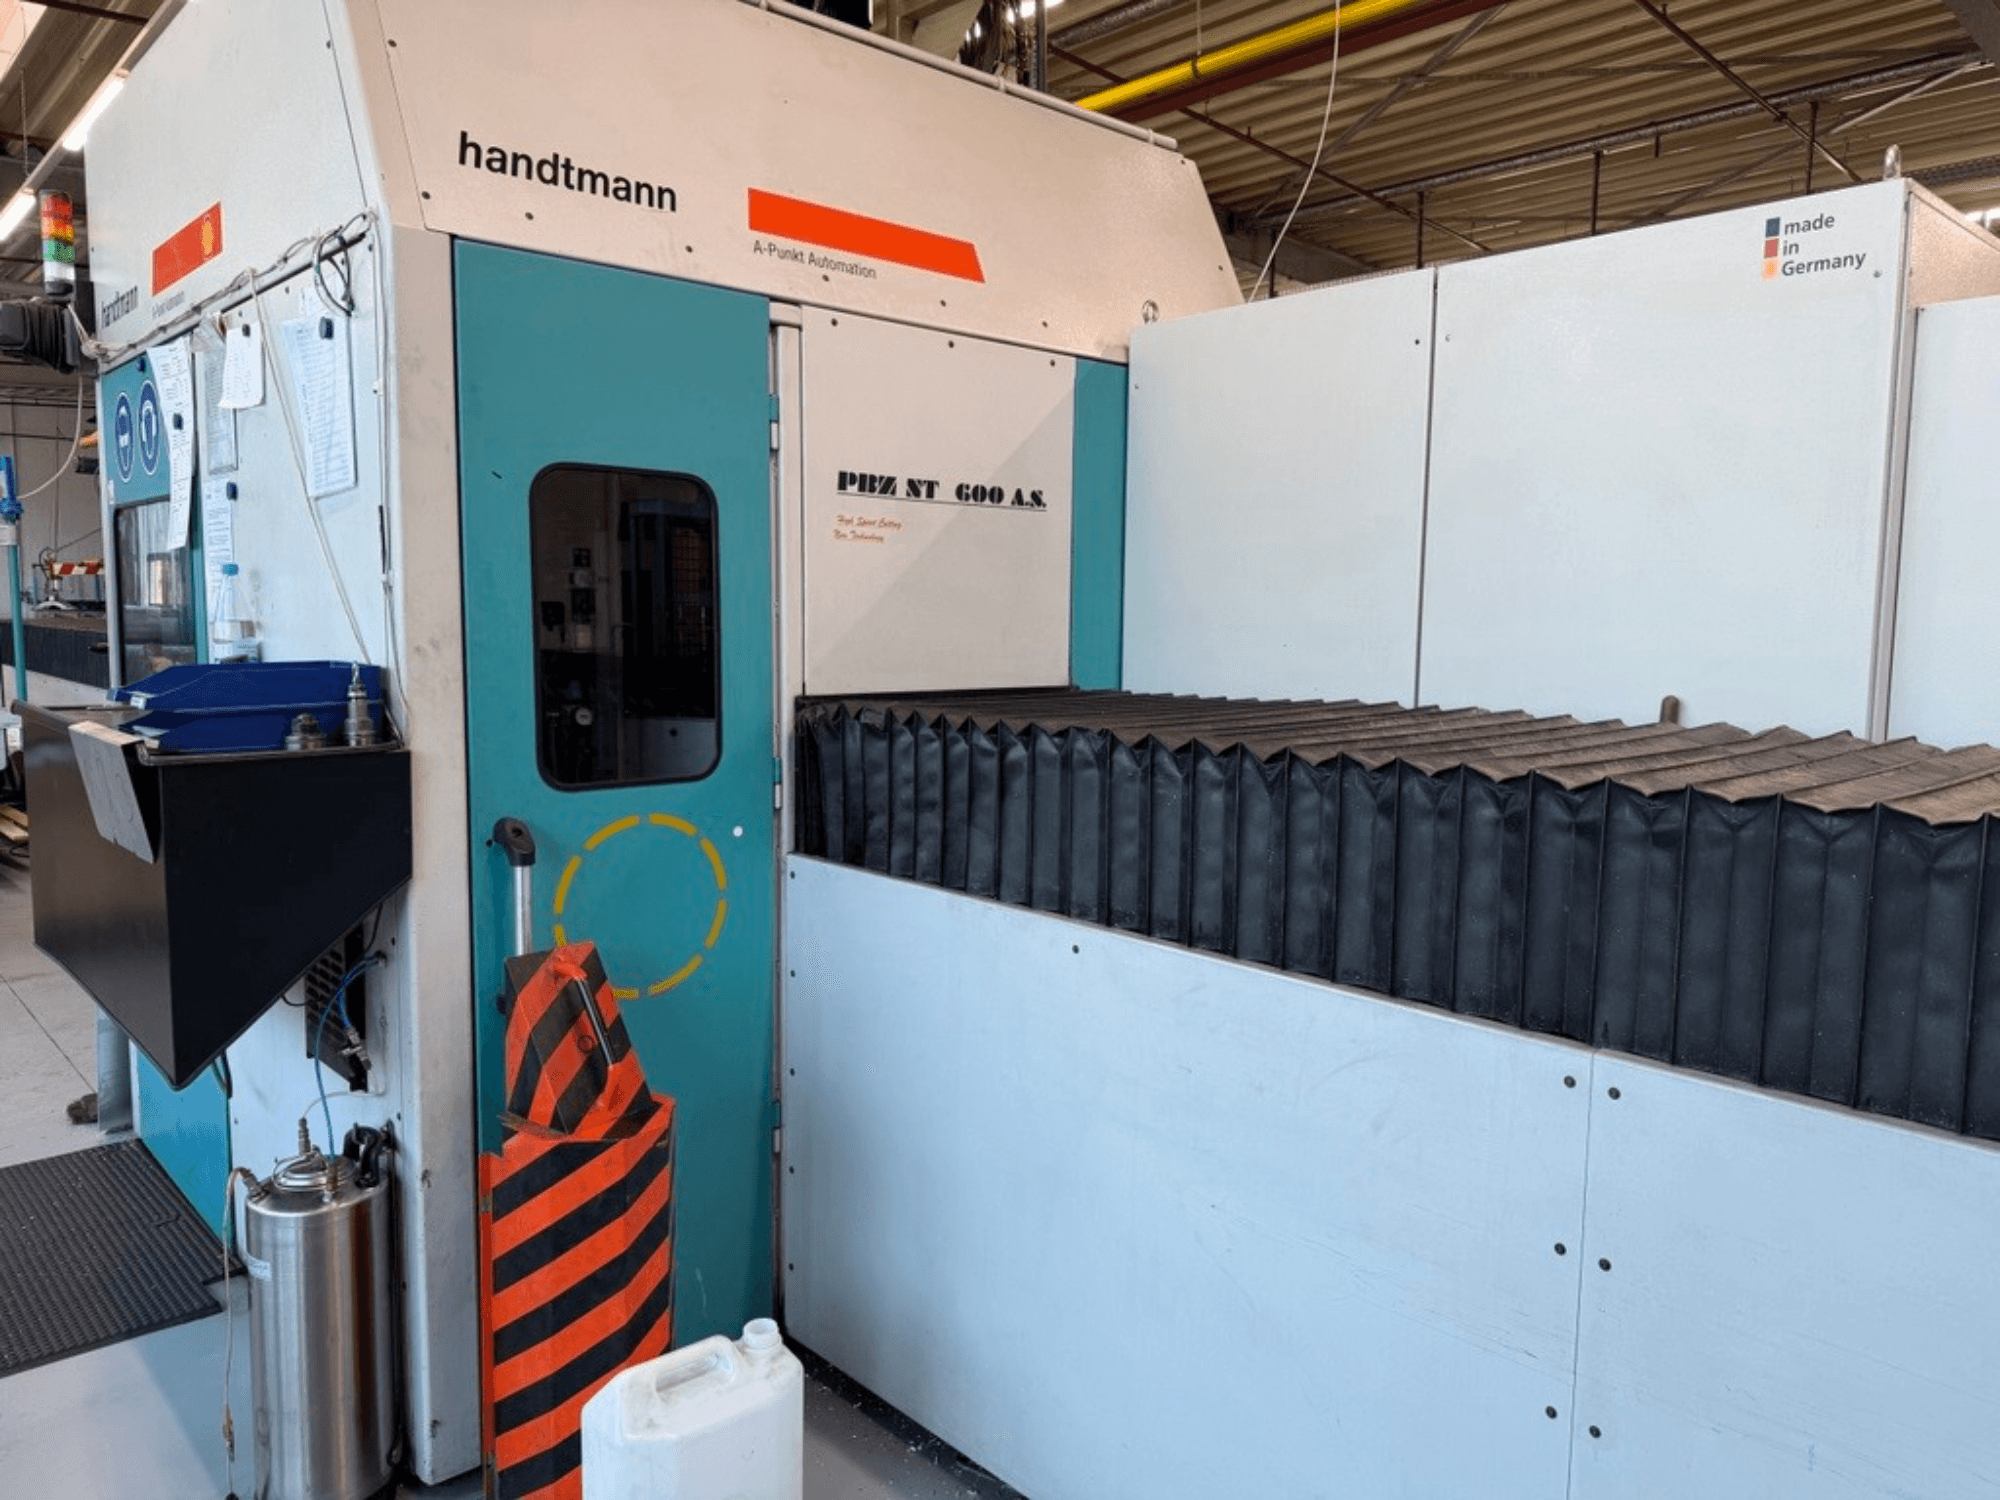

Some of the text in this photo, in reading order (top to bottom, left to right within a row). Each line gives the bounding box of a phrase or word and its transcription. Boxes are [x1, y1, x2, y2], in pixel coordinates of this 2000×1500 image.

[459, 131, 677, 212] handtmann
[1784, 213, 1835, 235] made
[753, 240, 877, 279] A-Punkt Automation
[1782, 240, 1799, 256] in
[1781, 253, 1867, 276] Germany
[837, 470, 897, 496] PBZ
[955, 483, 1004, 504] 600
